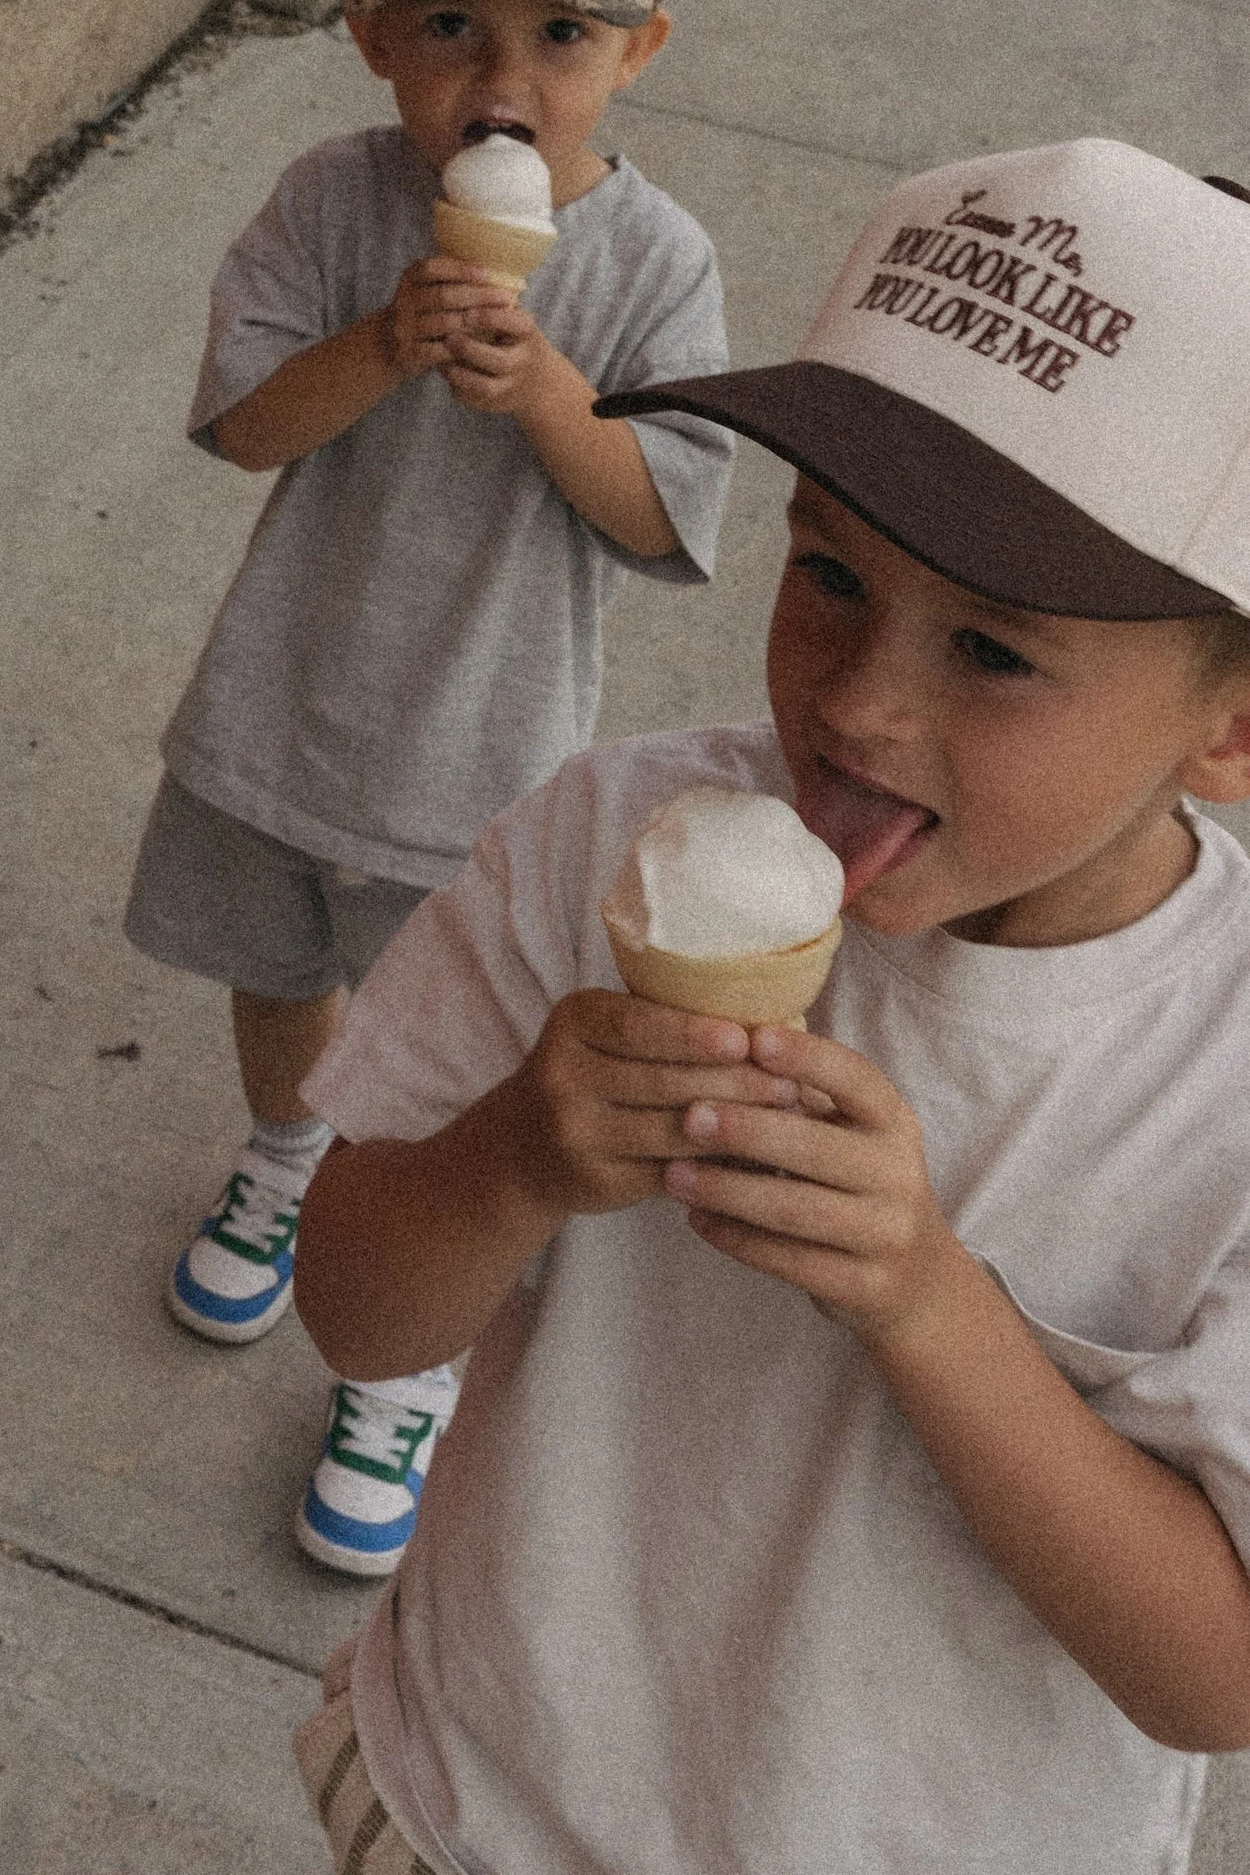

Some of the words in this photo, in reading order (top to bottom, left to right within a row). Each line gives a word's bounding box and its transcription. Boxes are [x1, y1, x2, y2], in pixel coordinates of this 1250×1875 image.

[904, 287, 1014, 356] LOVE
[996, 326, 1080, 393] ME
[923, 234, 1037, 306] LOOK
[1021, 273, 1136, 358] LIKE
